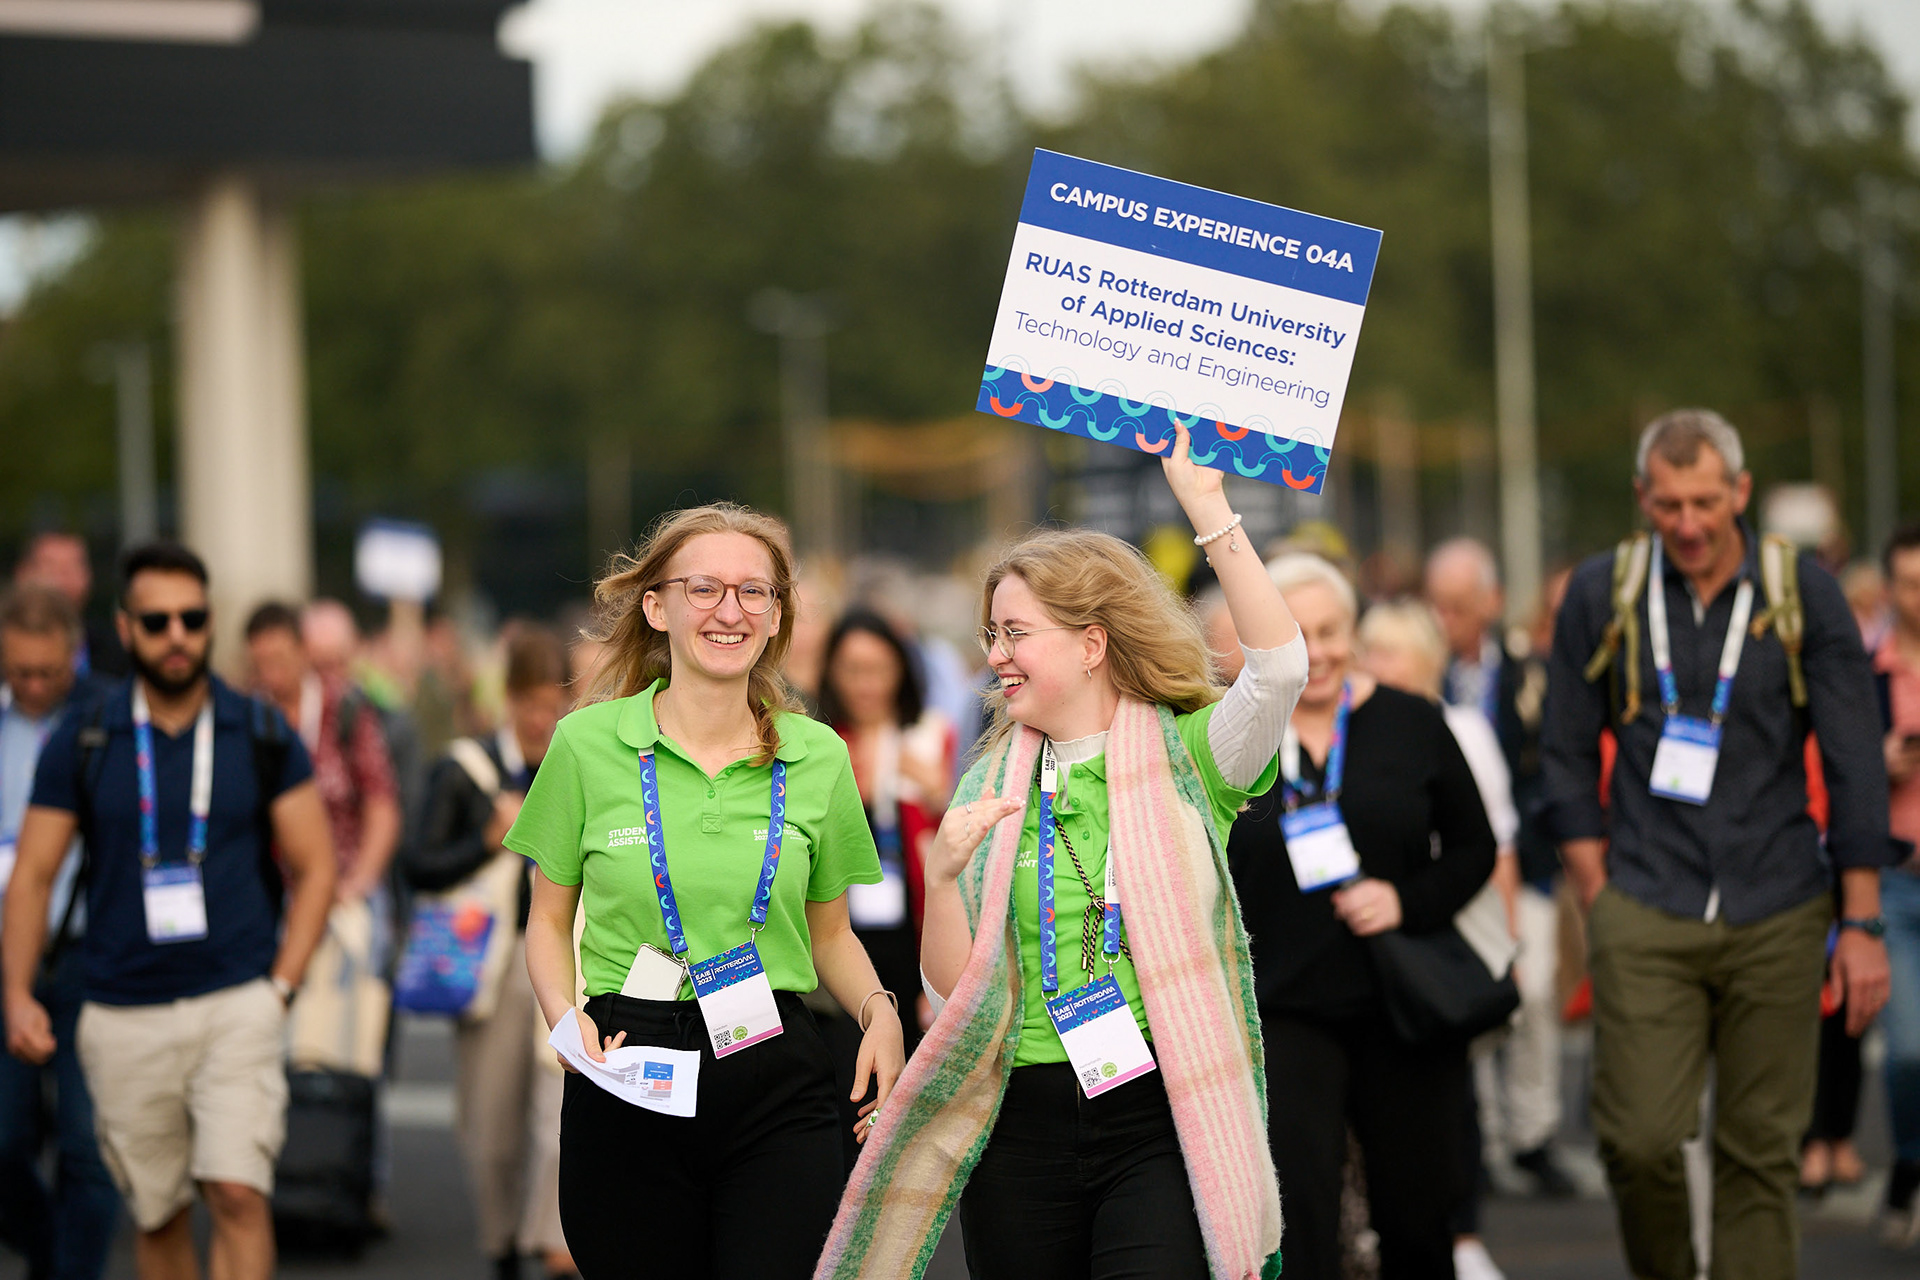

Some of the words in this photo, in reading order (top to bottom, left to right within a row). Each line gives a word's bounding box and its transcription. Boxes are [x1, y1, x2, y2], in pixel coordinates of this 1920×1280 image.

[1049, 181, 1148, 222] CAMPUS
[1152, 208, 1302, 260] EXPERIENCE
[1305, 244, 1355, 274] 04A
[1025, 251, 1093, 285] RUAS
[1098, 269, 1223, 317] Rotterdam
[1230, 302, 1347, 350] University
[1060, 294, 1088, 315] of
[1090, 301, 1183, 338] Applied
[1189, 324, 1297, 367] Sciences:
[1015, 310, 1142, 360] Technology
[1147, 346, 1192, 372] and
[1198, 356, 1331, 409] Engineering
[608, 826, 647, 839] STUDEN
[607, 836, 649, 848] ASSISTA
[714, 953, 755, 974] ROTTERDAM
[695, 969, 711, 980] EAIE
[697, 975, 713, 986] 2023
[1073, 986, 1116, 1009] ROTTERDAM
[1055, 1005, 1071, 1017] EAIE
[1057, 1011, 1073, 1023] 2023
